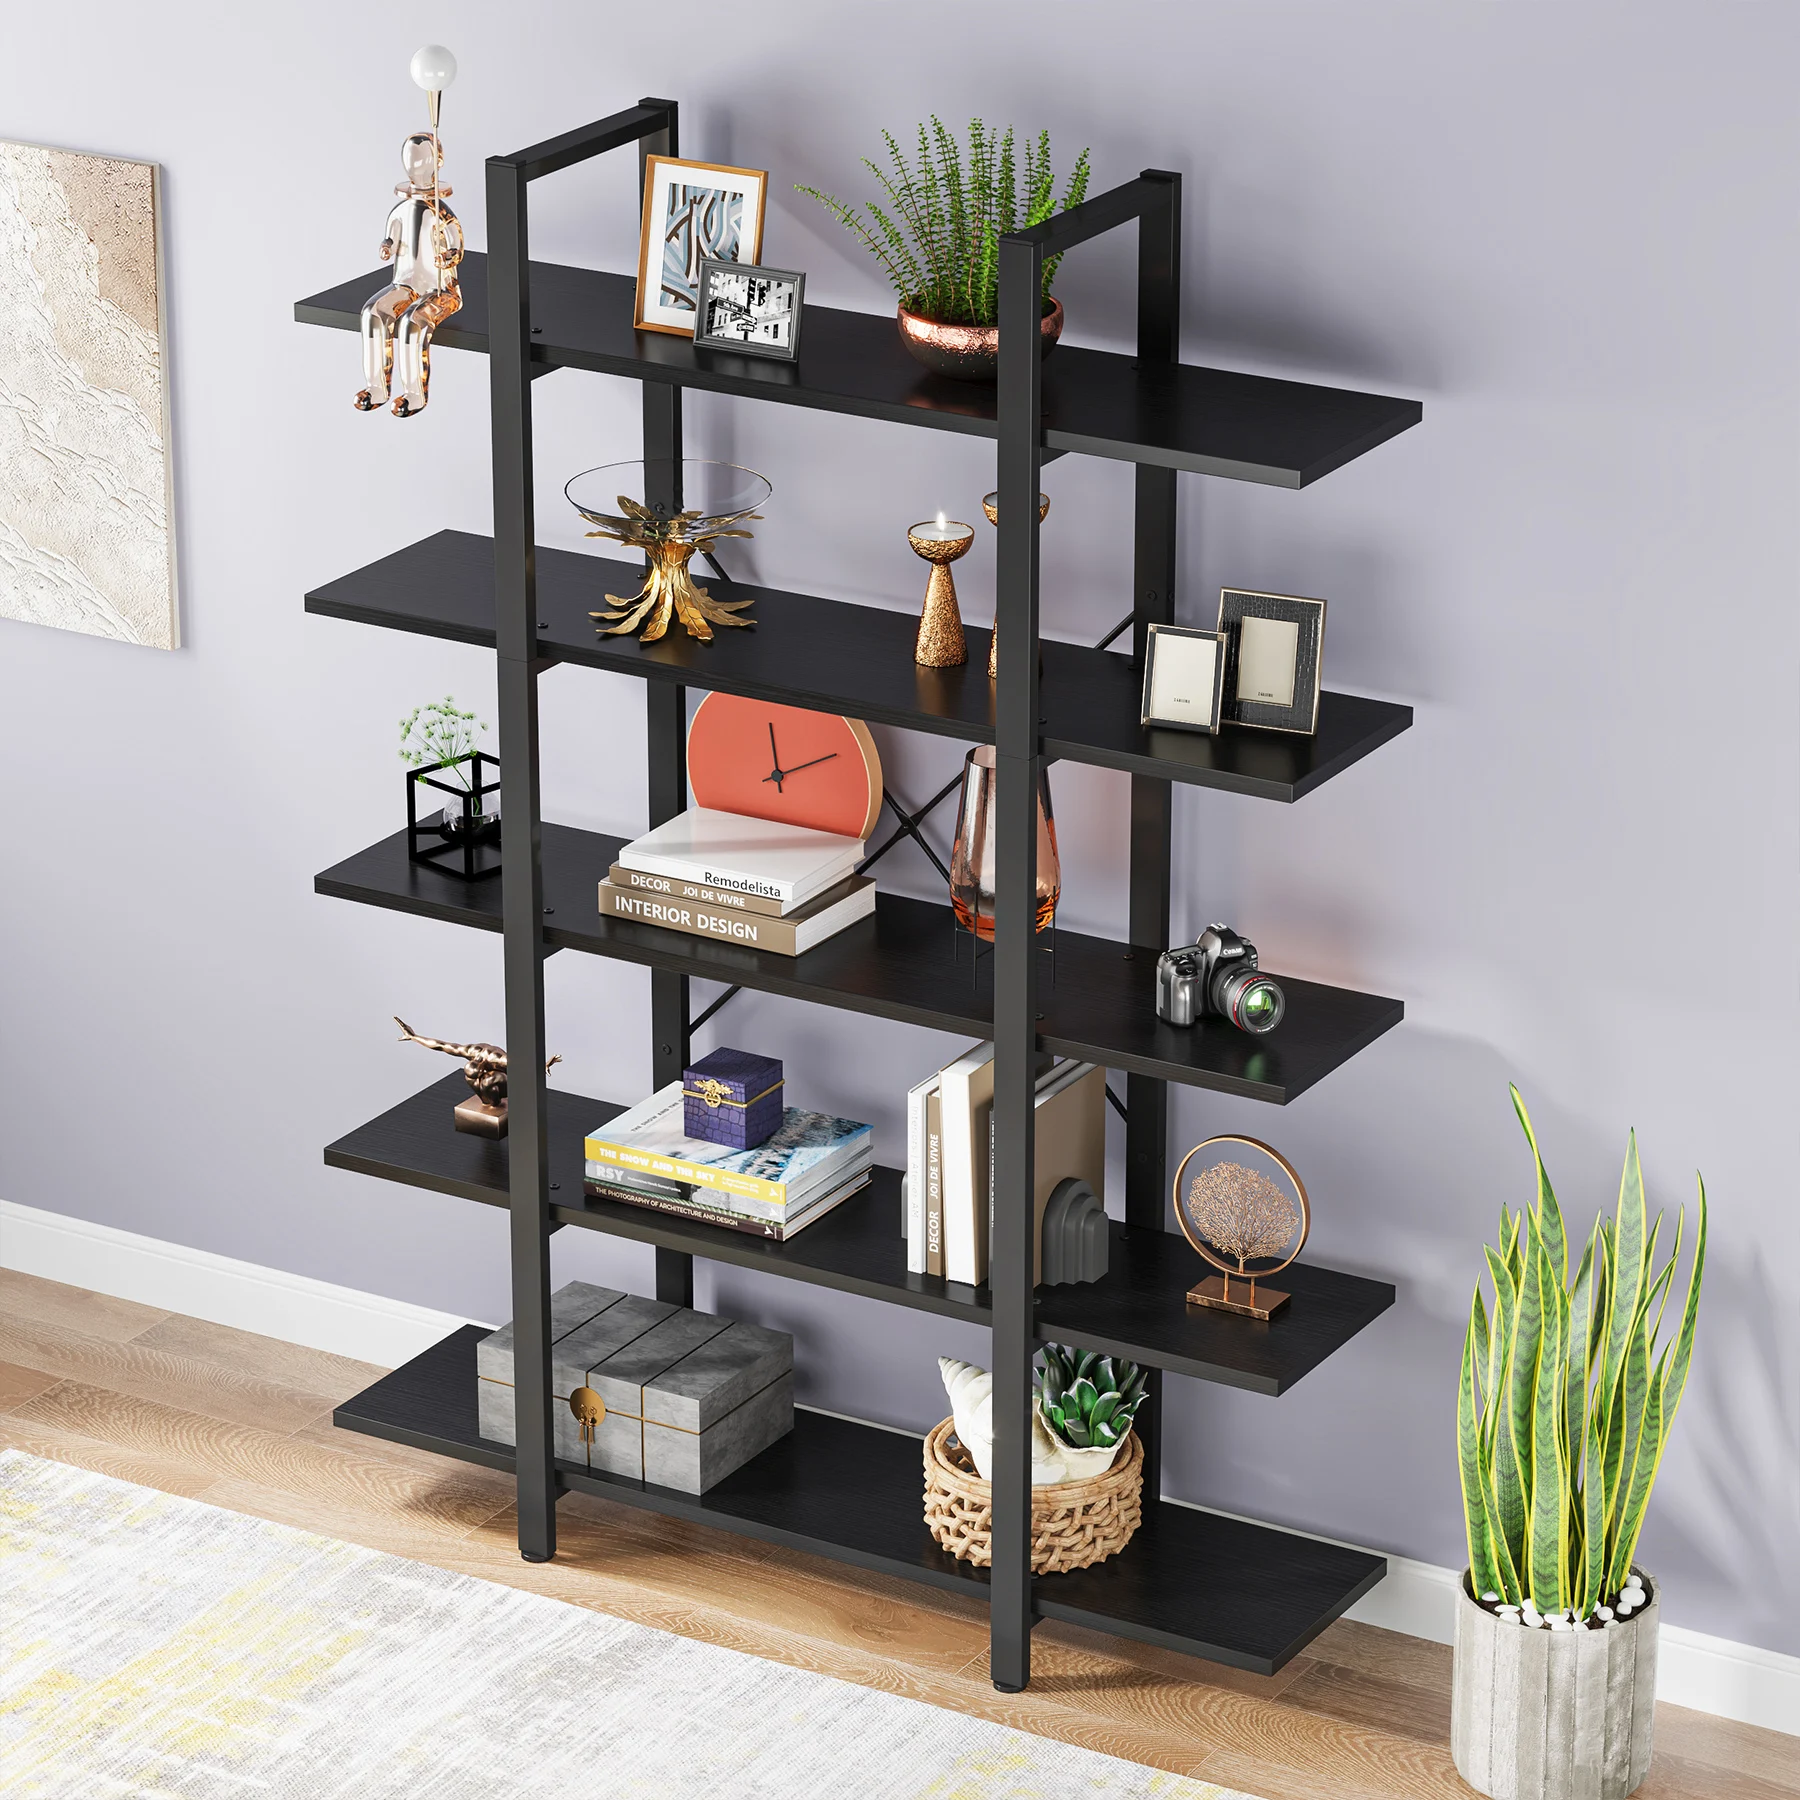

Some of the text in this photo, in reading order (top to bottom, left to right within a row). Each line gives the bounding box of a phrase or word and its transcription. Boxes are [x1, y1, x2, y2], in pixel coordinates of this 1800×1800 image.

[631, 874, 745, 907] DECOR JOI DE VIVRE
[705, 872, 781, 897] Remodelista
[615, 895, 757, 941] INTERIOR DESIGN
[596, 1164, 624, 1182] RSY
[599, 1147, 715, 1182] THE SNOW AND THE SKY
[595, 1186, 738, 1227] THE PHOTOGRAPHY OF ARCHITECTURE AND DESIGN
[929, 1133, 939, 1253] DECOR JOI DE VIVRE
